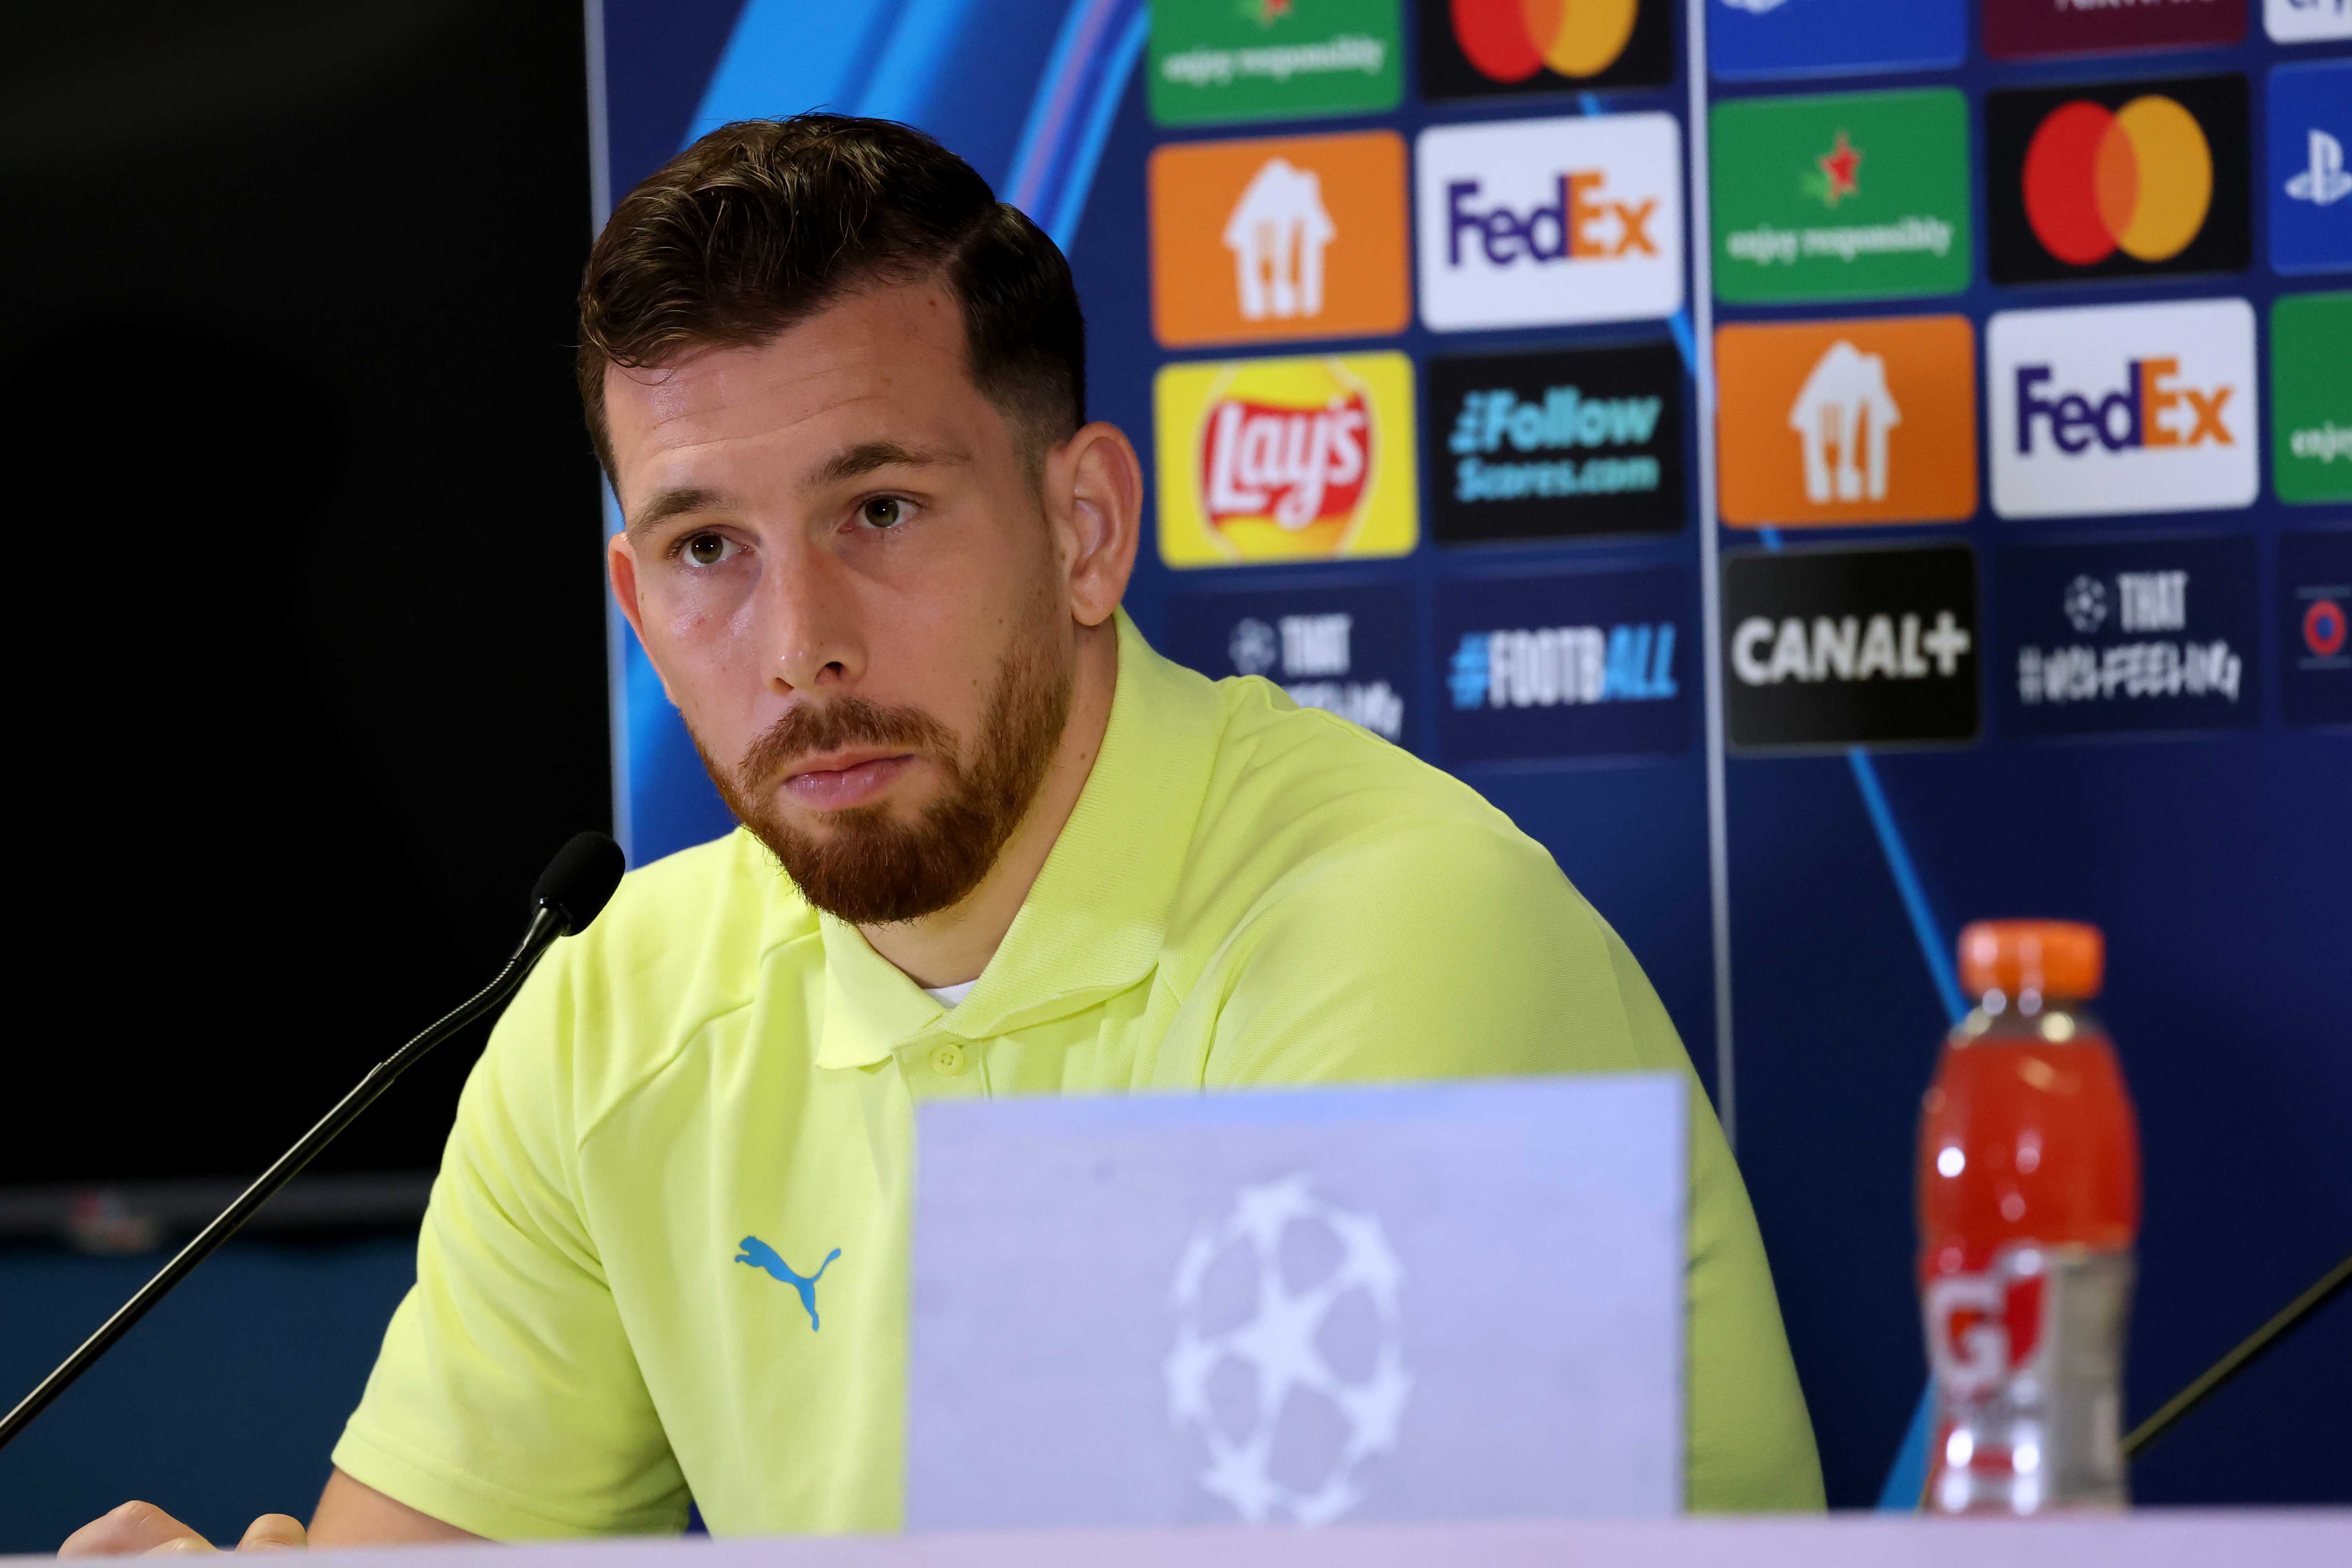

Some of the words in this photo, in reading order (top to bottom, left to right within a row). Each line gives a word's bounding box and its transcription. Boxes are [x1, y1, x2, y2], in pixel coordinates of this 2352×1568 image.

[1446, 169, 1657, 269] FedEx
[1727, 224, 1796, 265] enjoy
[1802, 216, 1952, 262] responsibly
[2016, 356, 2235, 455] FedEx
[1211, 394, 1366, 531] Lay's
[2118, 570, 2188, 632] THAT
[1447, 623, 1678, 708] #FOOTBALL
[1732, 610, 1971, 686] CANAL+
